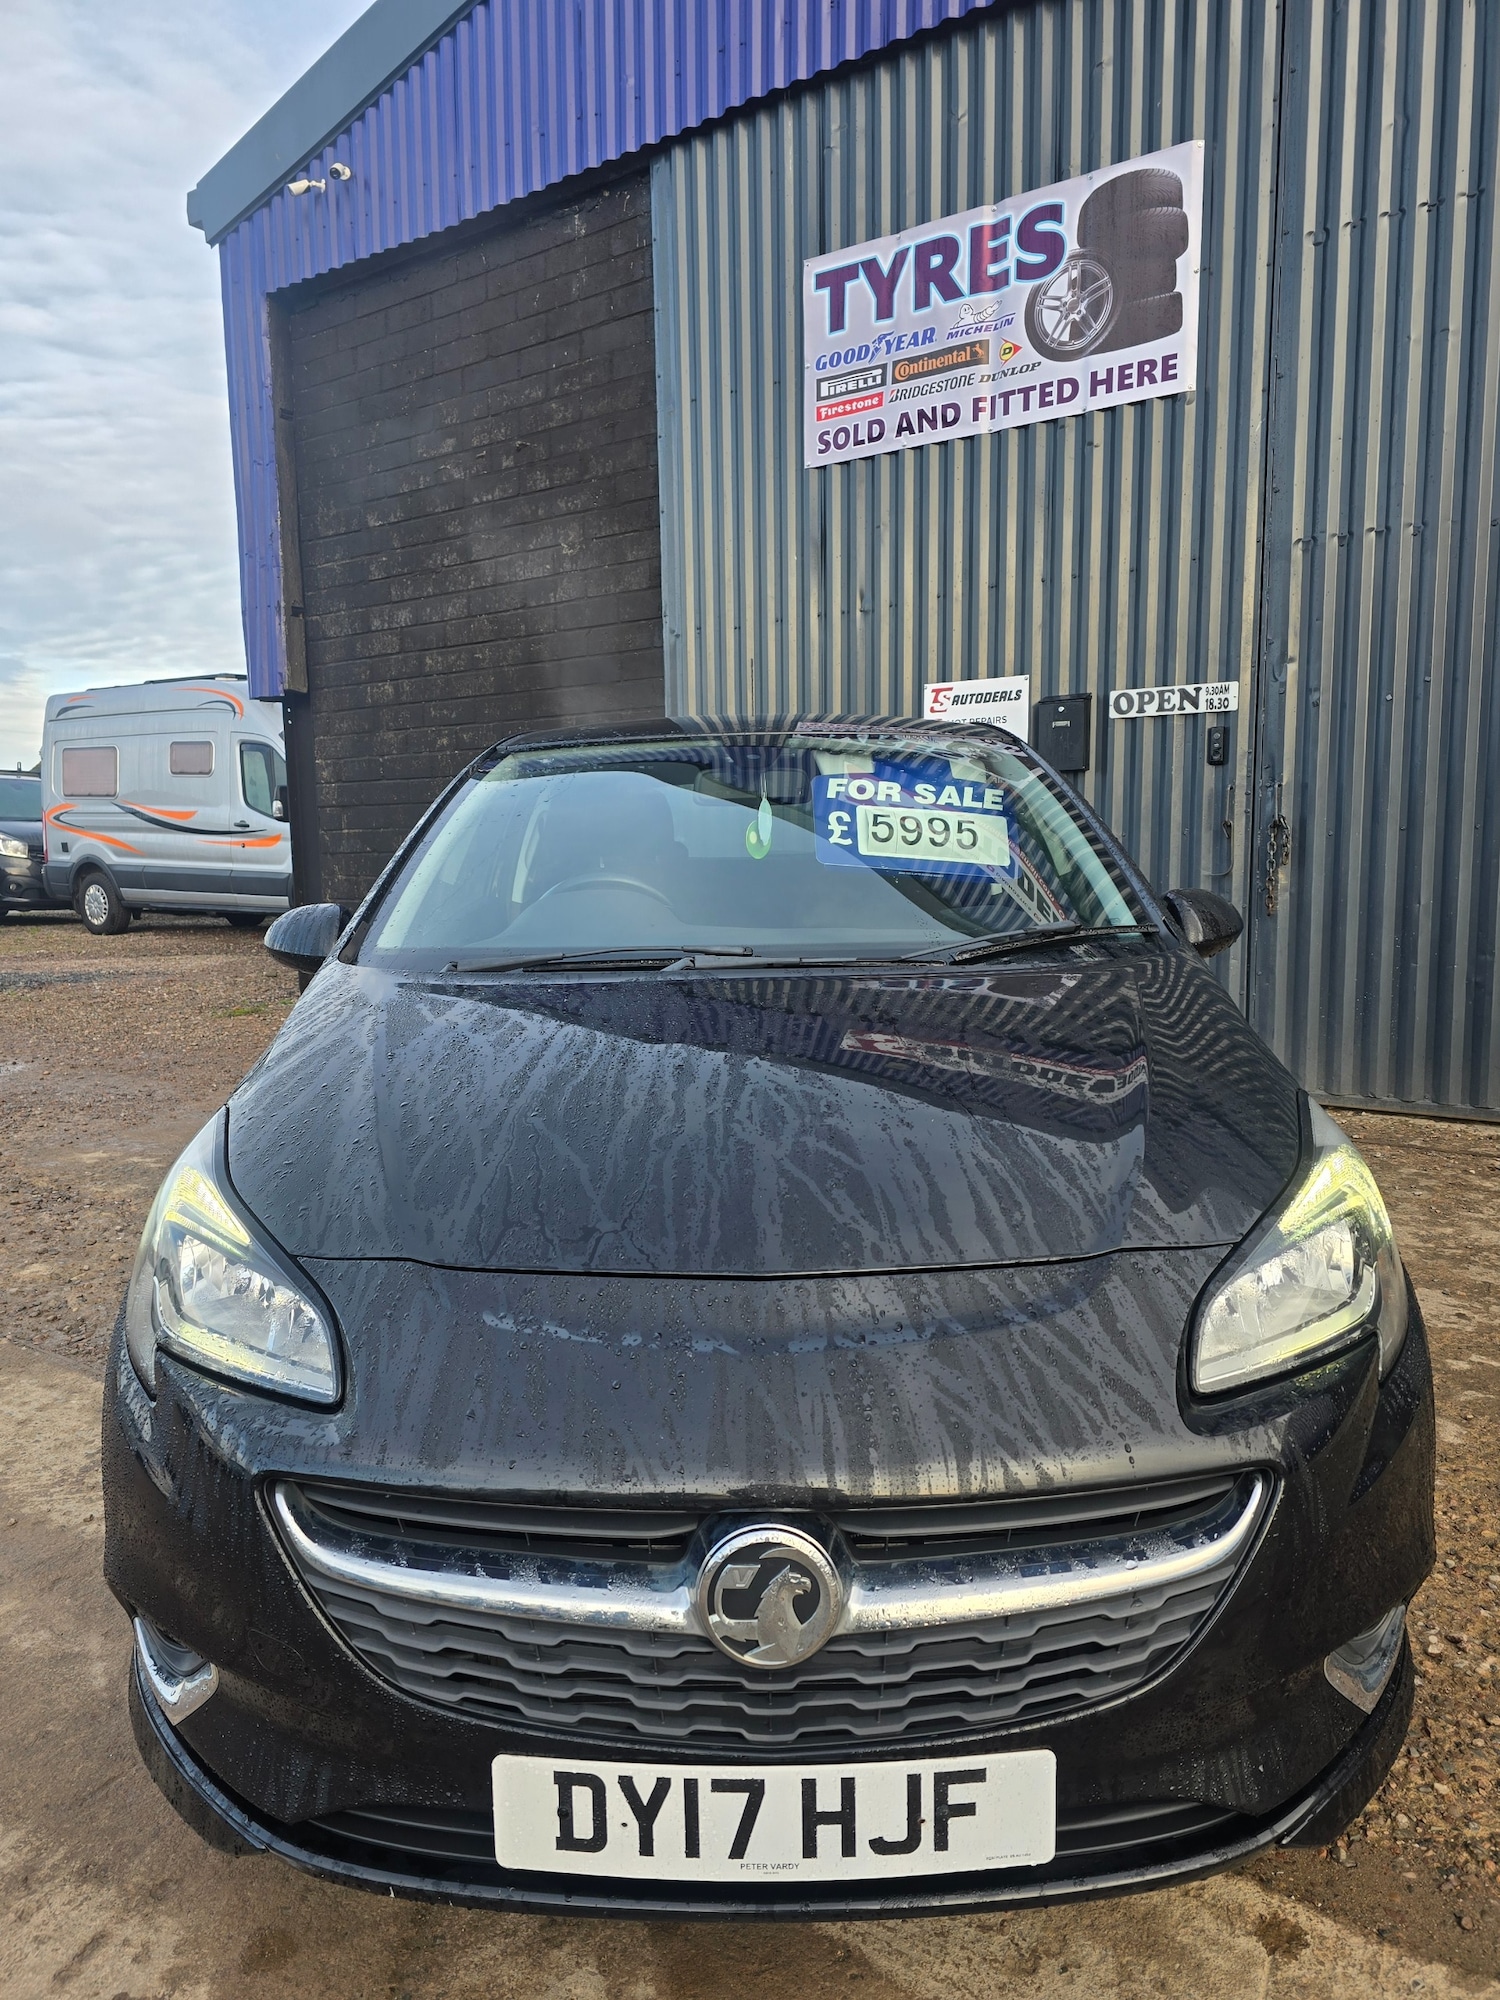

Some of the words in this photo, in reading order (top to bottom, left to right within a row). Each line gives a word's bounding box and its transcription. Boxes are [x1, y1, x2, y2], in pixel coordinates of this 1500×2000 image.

[814, 201, 1067, 334] TYRES
[946, 317, 1014, 340] MICHELIN
[894, 345, 971, 381] Continental
[978, 361, 1042, 384] DUNLOP
[820, 368, 883, 398] PIRELLI
[888, 373, 976, 404] BRIDGESTONE
[817, 418, 886, 455] SOLD
[895, 402, 962, 439] AND
[972, 376, 1080, 423] FITTED
[1088, 353, 1179, 398] HERE
[820, 396, 881, 420] Firestone
[951, 689, 1023, 706] AUTODEALS
[1113, 686, 1202, 716] OPEN
[1205, 683, 1230, 697] 9.30AM
[1205, 697, 1230, 711] 18.30
[826, 777, 902, 803] FOR
[913, 783, 1004, 811] SALE
[871, 814, 979, 850] 5995
[554, 1770, 766, 1860] DY17
[801, 1768, 987, 1859] HJF
[770, 1862, 800, 1870] VARDY
